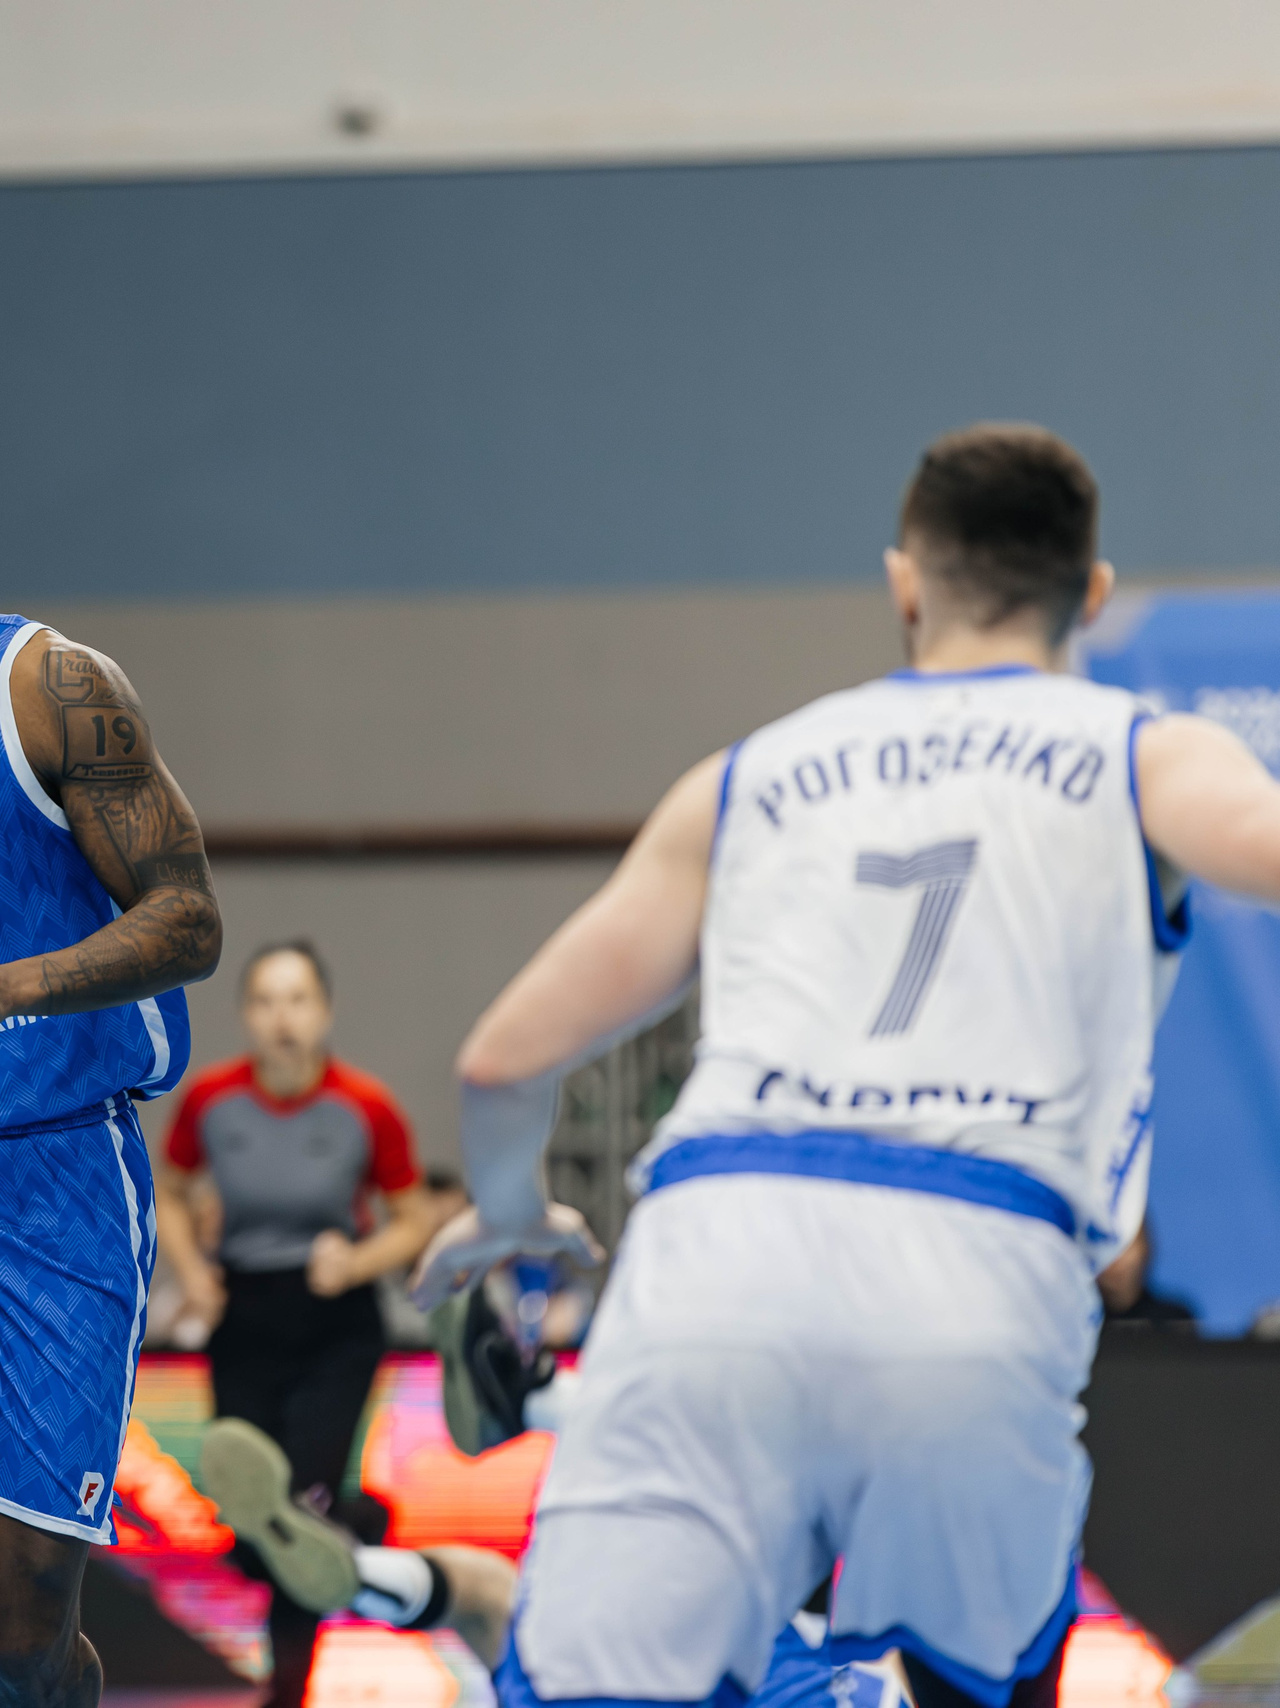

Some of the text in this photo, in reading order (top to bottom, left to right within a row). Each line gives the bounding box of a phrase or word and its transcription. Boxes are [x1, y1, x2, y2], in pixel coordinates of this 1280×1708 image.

[91, 714, 137, 757] 19
[755, 716, 1105, 829] РОГОЗЕНКО
[854, 837, 979, 1042] 7
